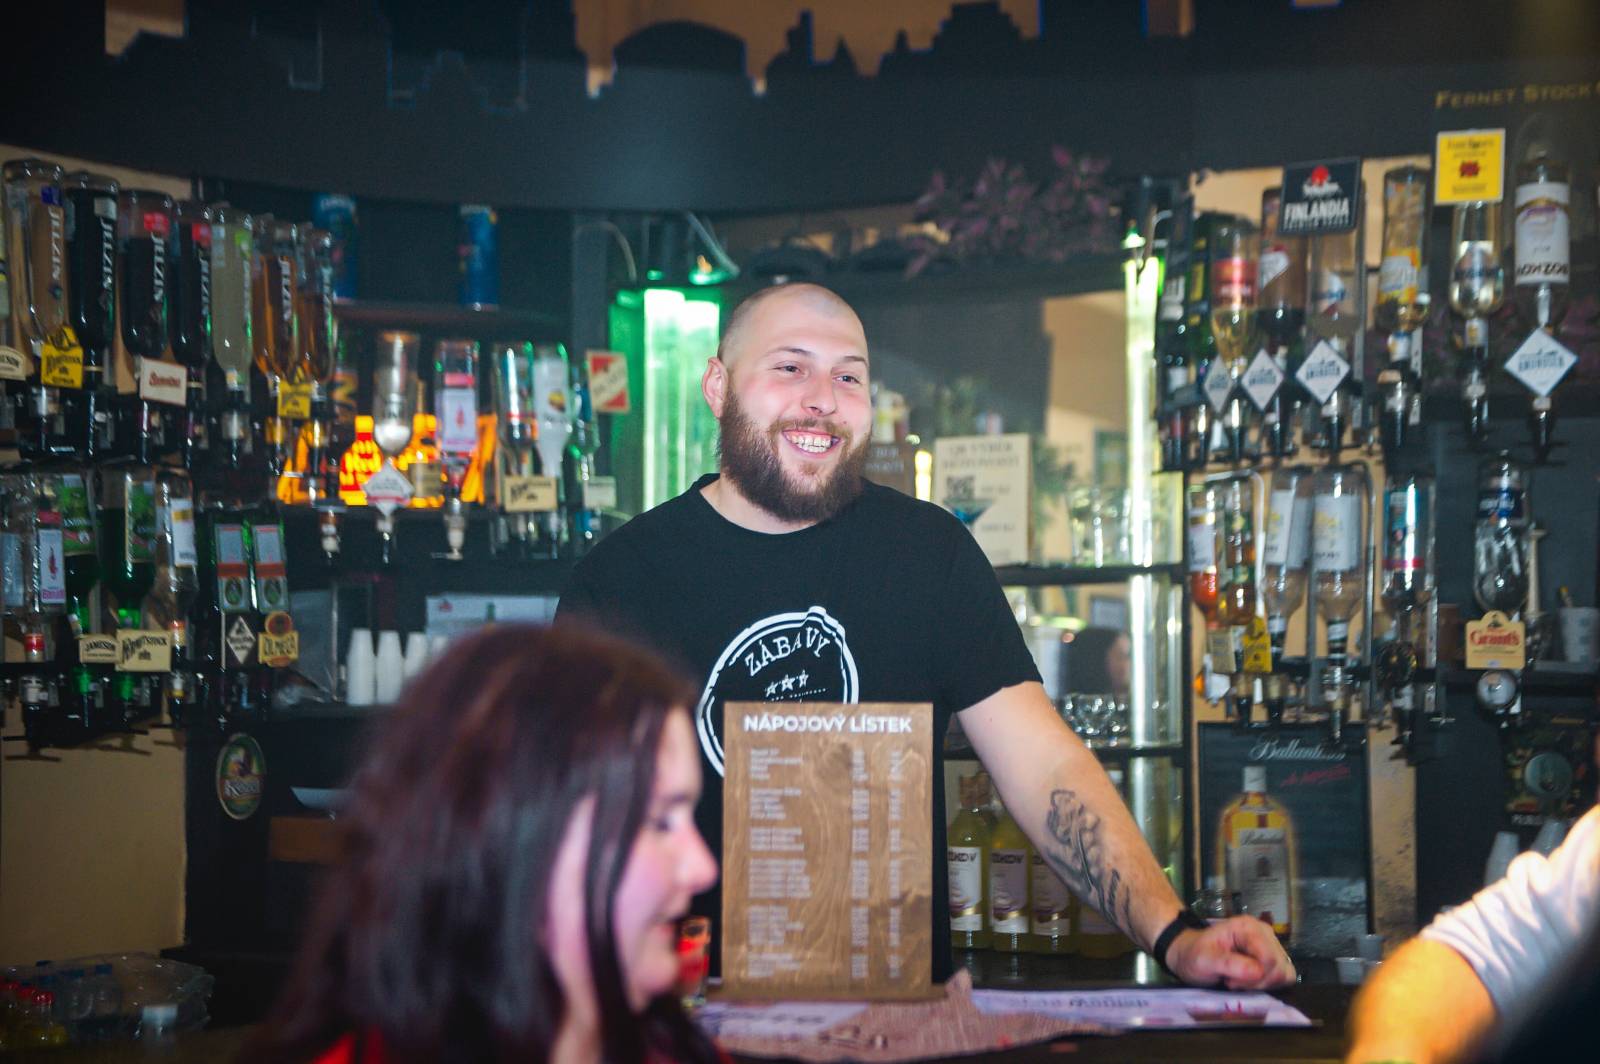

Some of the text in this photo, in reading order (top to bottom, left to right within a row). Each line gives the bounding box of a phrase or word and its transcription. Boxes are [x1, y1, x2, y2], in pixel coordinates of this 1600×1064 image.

[1284, 198, 1349, 224] FINLANDIA
[745, 626, 830, 677] ZÁBAVY
[743, 711, 912, 734] NÁPOJOVÝ LÍSTEK
